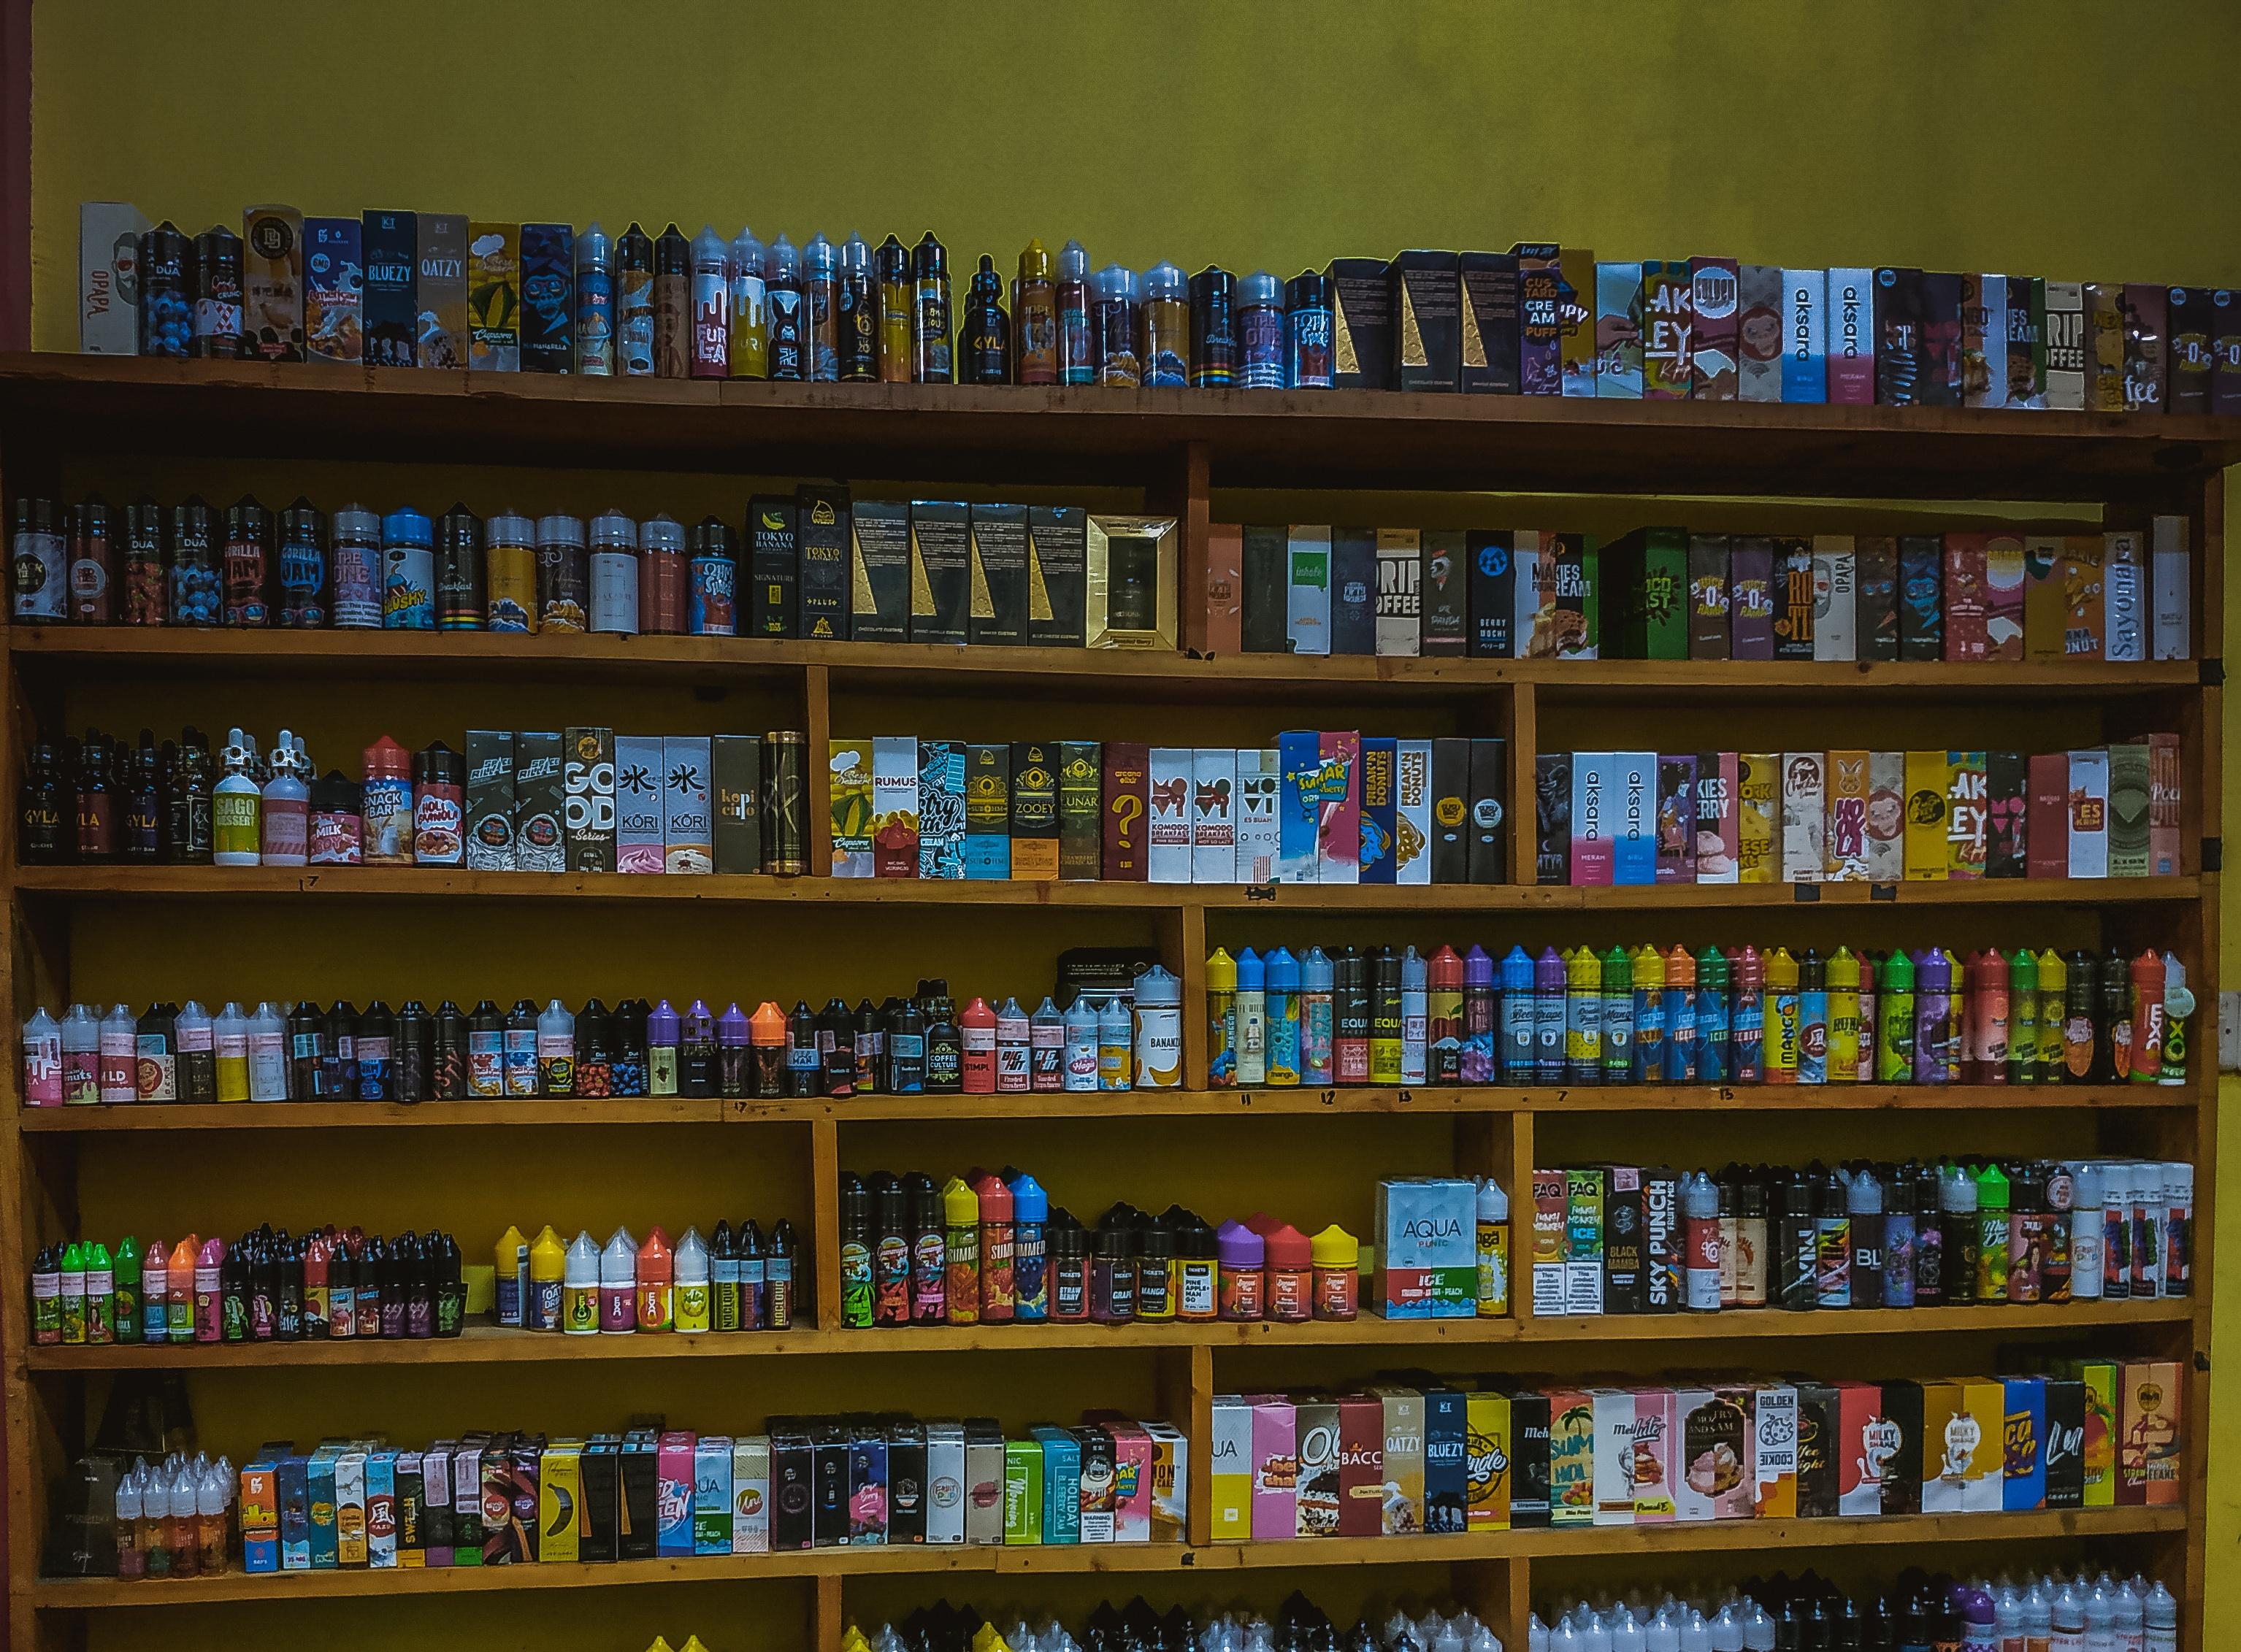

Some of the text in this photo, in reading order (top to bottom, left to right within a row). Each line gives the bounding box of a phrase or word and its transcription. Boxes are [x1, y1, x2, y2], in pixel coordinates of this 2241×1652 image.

[156, 266, 181, 277] DUA
[368, 264, 412, 283] BLUEZY
[421, 258, 462, 278] OATZY
[1525, 277, 1553, 291] CUS
[86, 269, 109, 320] OPAPA
[1524, 287, 1558, 299] TARD
[1525, 300, 1553, 312] CRE
[1530, 312, 1555, 325] AM
[1795, 288, 1810, 362] aksara
[1842, 285, 1861, 359] aksara
[1525, 326, 1557, 338] PUFF
[183, 537, 208, 548] DUA
[756, 531, 794, 542] TOKYO
[131, 539, 155, 550] DUA
[756, 541, 793, 549] BANANA
[338, 552, 361, 565] THE
[805, 547, 840, 558] TOKYO
[754, 574, 794, 582] SIGNATURE
[1835, 556, 1855, 593] OPAPA
[875, 777, 917, 786] RUMUS
[1365, 750, 1376, 806] FREAK'N
[1376, 750, 1387, 806] DONUTS
[1401, 752, 1411, 807] FREAK'N
[1411, 752, 1422, 807] DONUTS
[217, 798, 255, 816] SAGO
[369, 805, 394, 818] BAR
[1016, 803, 1056, 814] ZOOEY
[1585, 770, 1599, 842] aksara
[1626, 770, 1641, 842] aksara
[2080, 804, 2101, 818] ES
[316, 823, 342, 837] MILK
[1152, 823, 1190, 831] KOMODO
[1195, 823, 1233, 831] KOMODO
[930, 1054, 957, 1062] COFFEE
[1533, 1183, 1562, 1198] FAQ
[1567, 1182, 1599, 1198] FAQ
[1668, 1200, 1676, 1233] FRUITY
[1403, 1219, 1462, 1239] AQUA
[1573, 1228, 1596, 1238] ICE
[1649, 1180, 1667, 1306] SKY PUNCH
[1609, 1245, 1638, 1258] BLACK
[1608, 1258, 1640, 1270] MAMBA
[1141, 1287, 1165, 1296] MANGO
[1759, 1395, 1794, 1407] GOLDEN
[1869, 1429, 1895, 1441] MILKY
[1950, 1426, 1975, 1437] MILKY
[1387, 1436, 1420, 1453] OATZY
[1428, 1442, 1464, 1459] BLUEZY
[1341, 1451, 1382, 1465] BACC
[1067, 1478, 1079, 1529] HOLIDAY
[370, 1502, 394, 1524] 風
[1057, 1513, 1065, 1531] JAM
